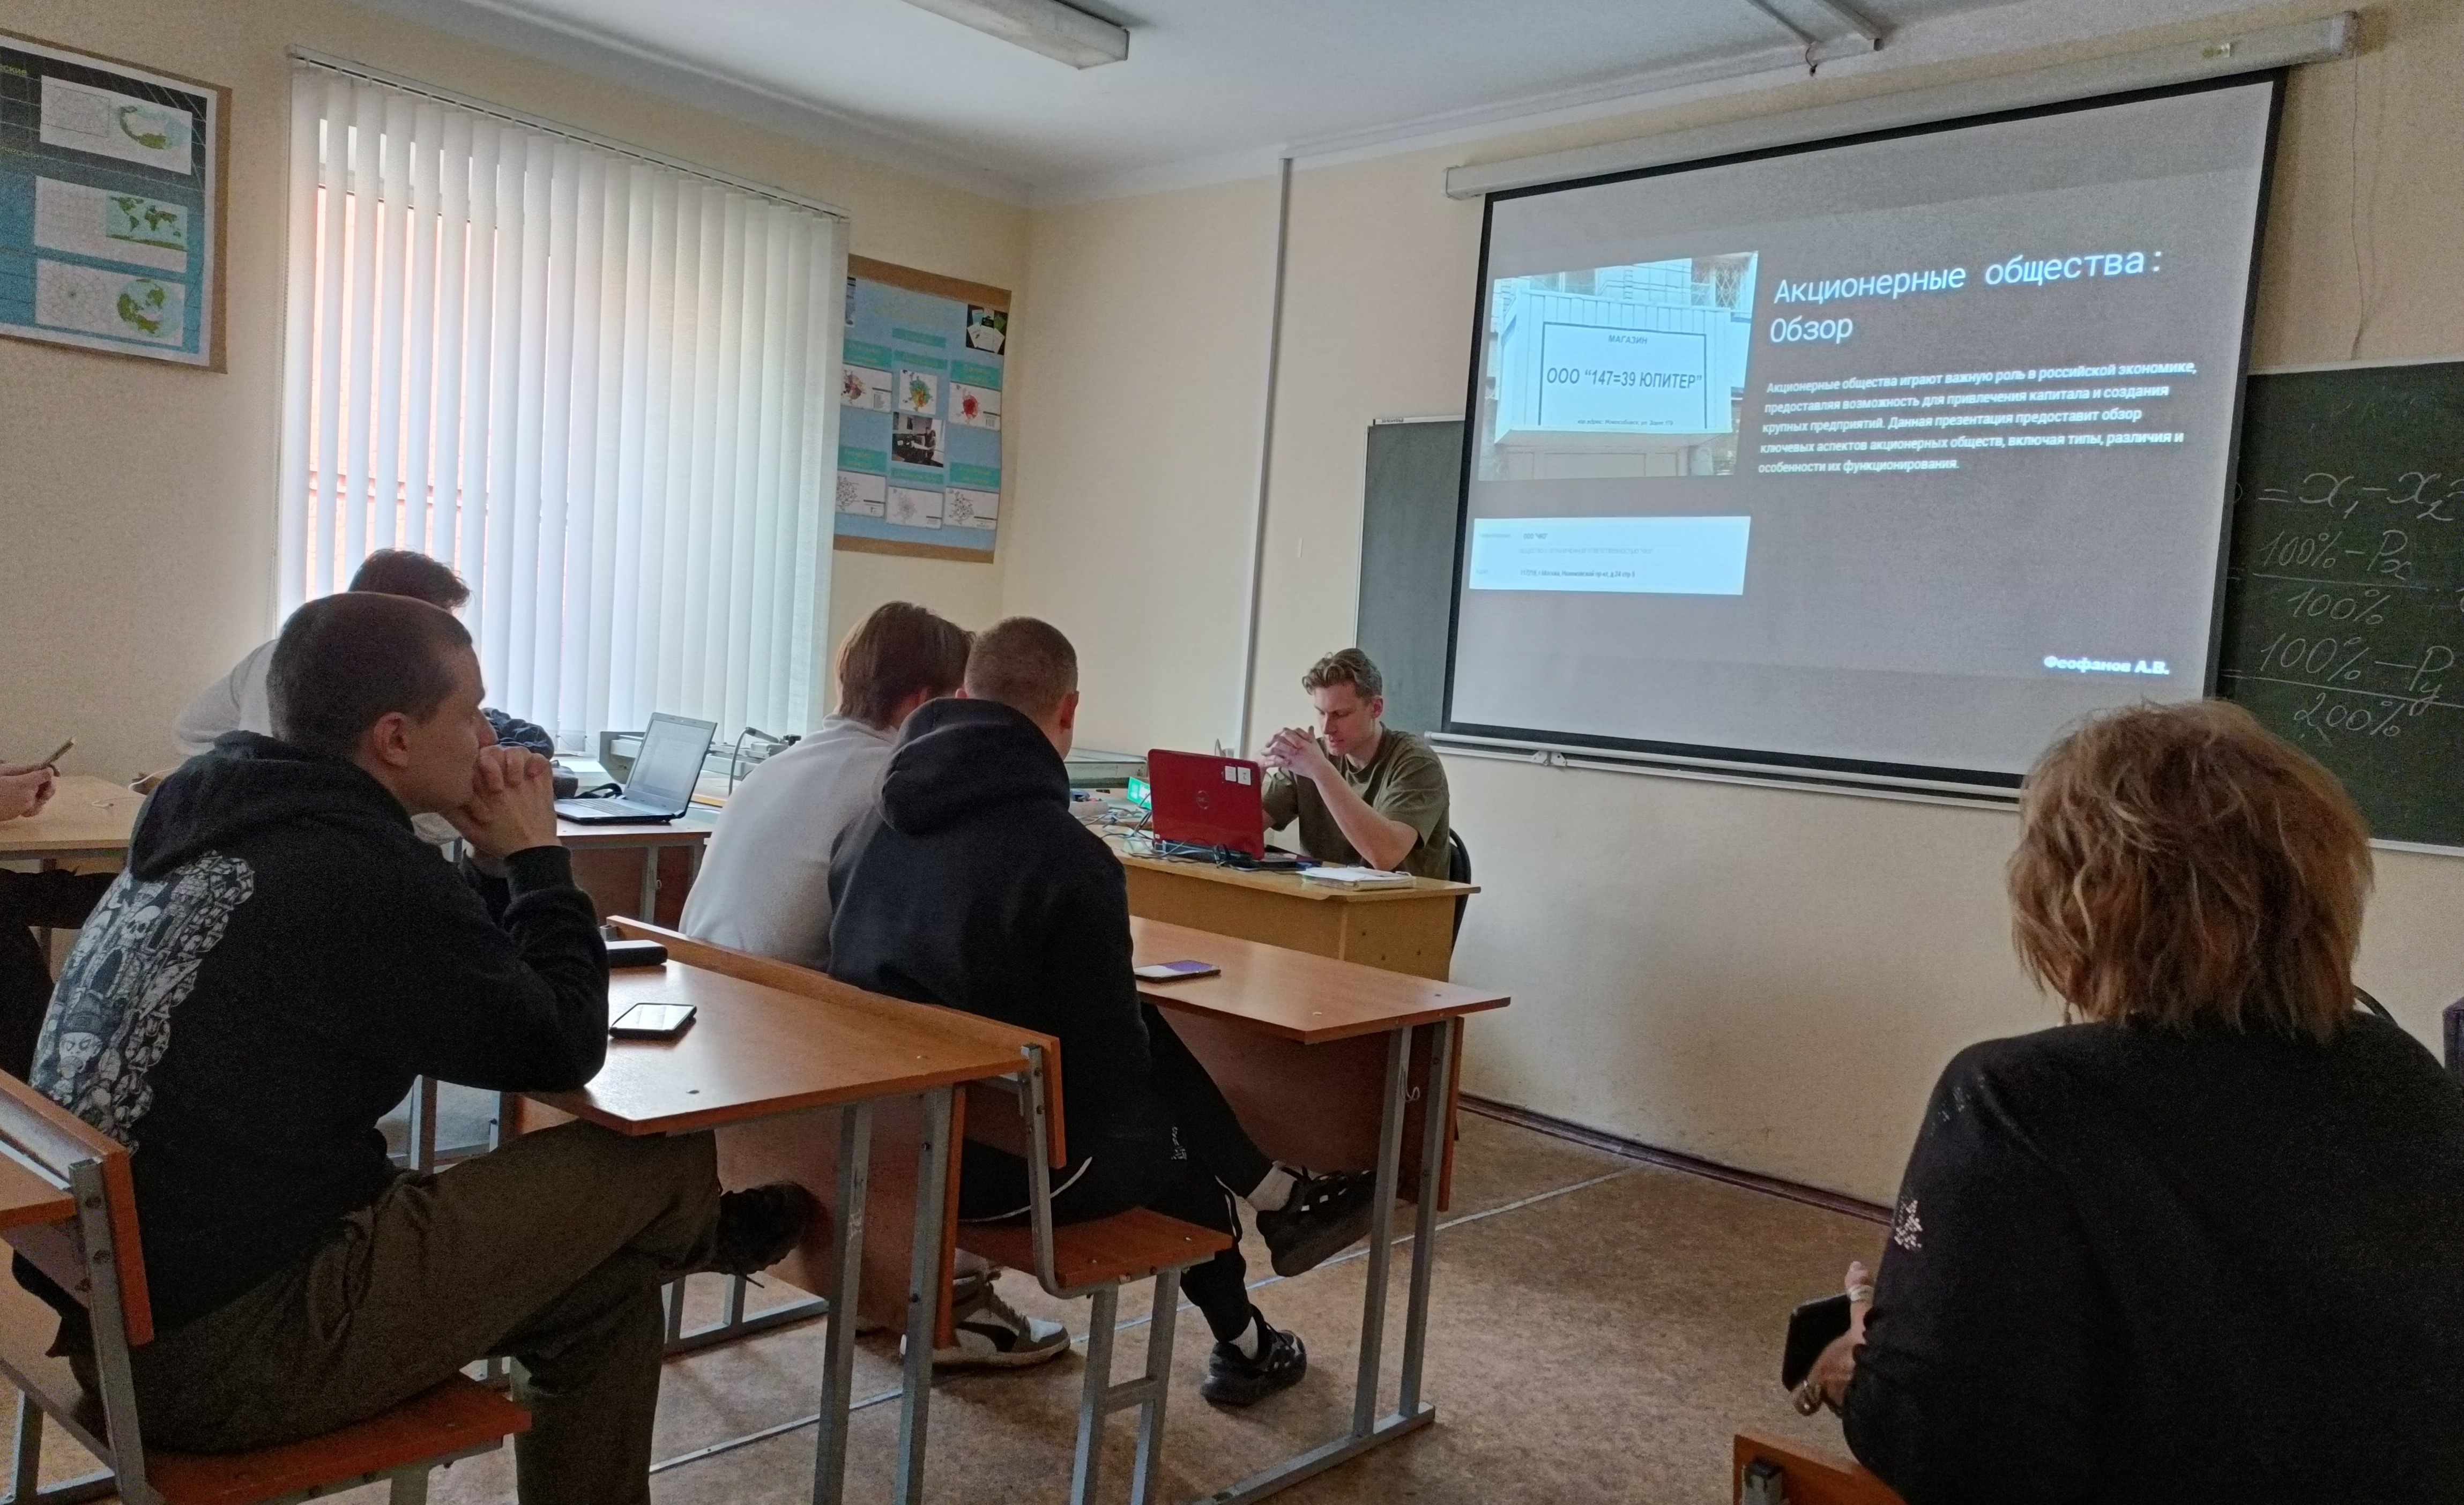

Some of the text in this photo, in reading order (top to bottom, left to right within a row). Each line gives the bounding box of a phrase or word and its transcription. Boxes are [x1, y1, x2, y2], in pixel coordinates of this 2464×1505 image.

[1774, 267, 1966, 304] Акционерные
[1608, 334, 1648, 345] МАГАЗИН
[1770, 316, 1853, 344] Обзор
[1547, 367, 1580, 384] ООО
[1767, 362, 2197, 393] Акционерные общества играют важную роль в российской экономике,
[1765, 385, 2169, 415] предоставляя возможность для привлечения капитала и создания
[1762, 407, 2142, 435] крупных предприятий. Данная презентация предоставит обзор
[1760, 432, 2184, 453] ключевых аспектов акционерных обществ, включая типы, различия и
[1758, 458, 1960, 474] особенности их функционирования.
[2044, 655, 2131, 673] Феофанов
